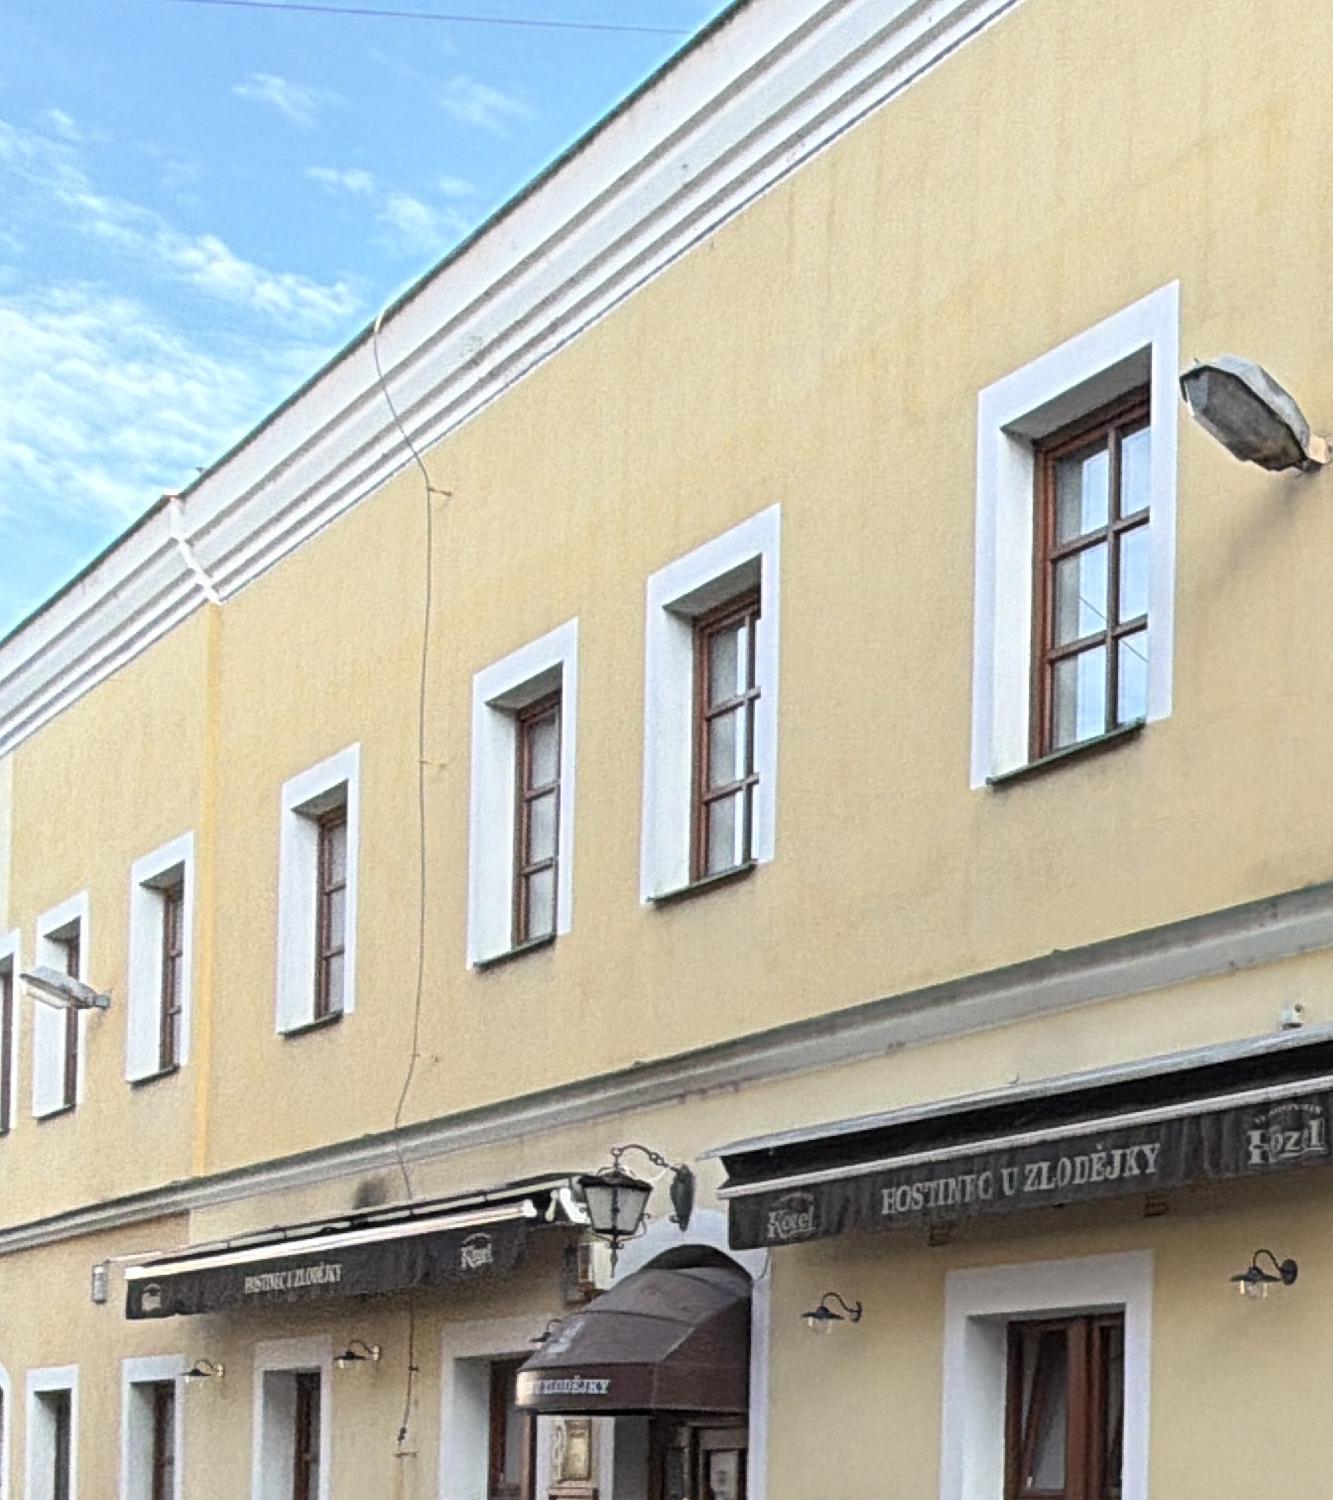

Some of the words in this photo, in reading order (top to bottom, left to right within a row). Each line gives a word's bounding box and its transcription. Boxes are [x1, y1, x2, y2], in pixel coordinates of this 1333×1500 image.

[1247, 1118, 1328, 1165] Kozl
[881, 1171, 994, 1215] HOSTINEC
[1001, 1167, 1019, 1196] U
[1024, 1143, 1161, 1193] ZLODĚJKY
